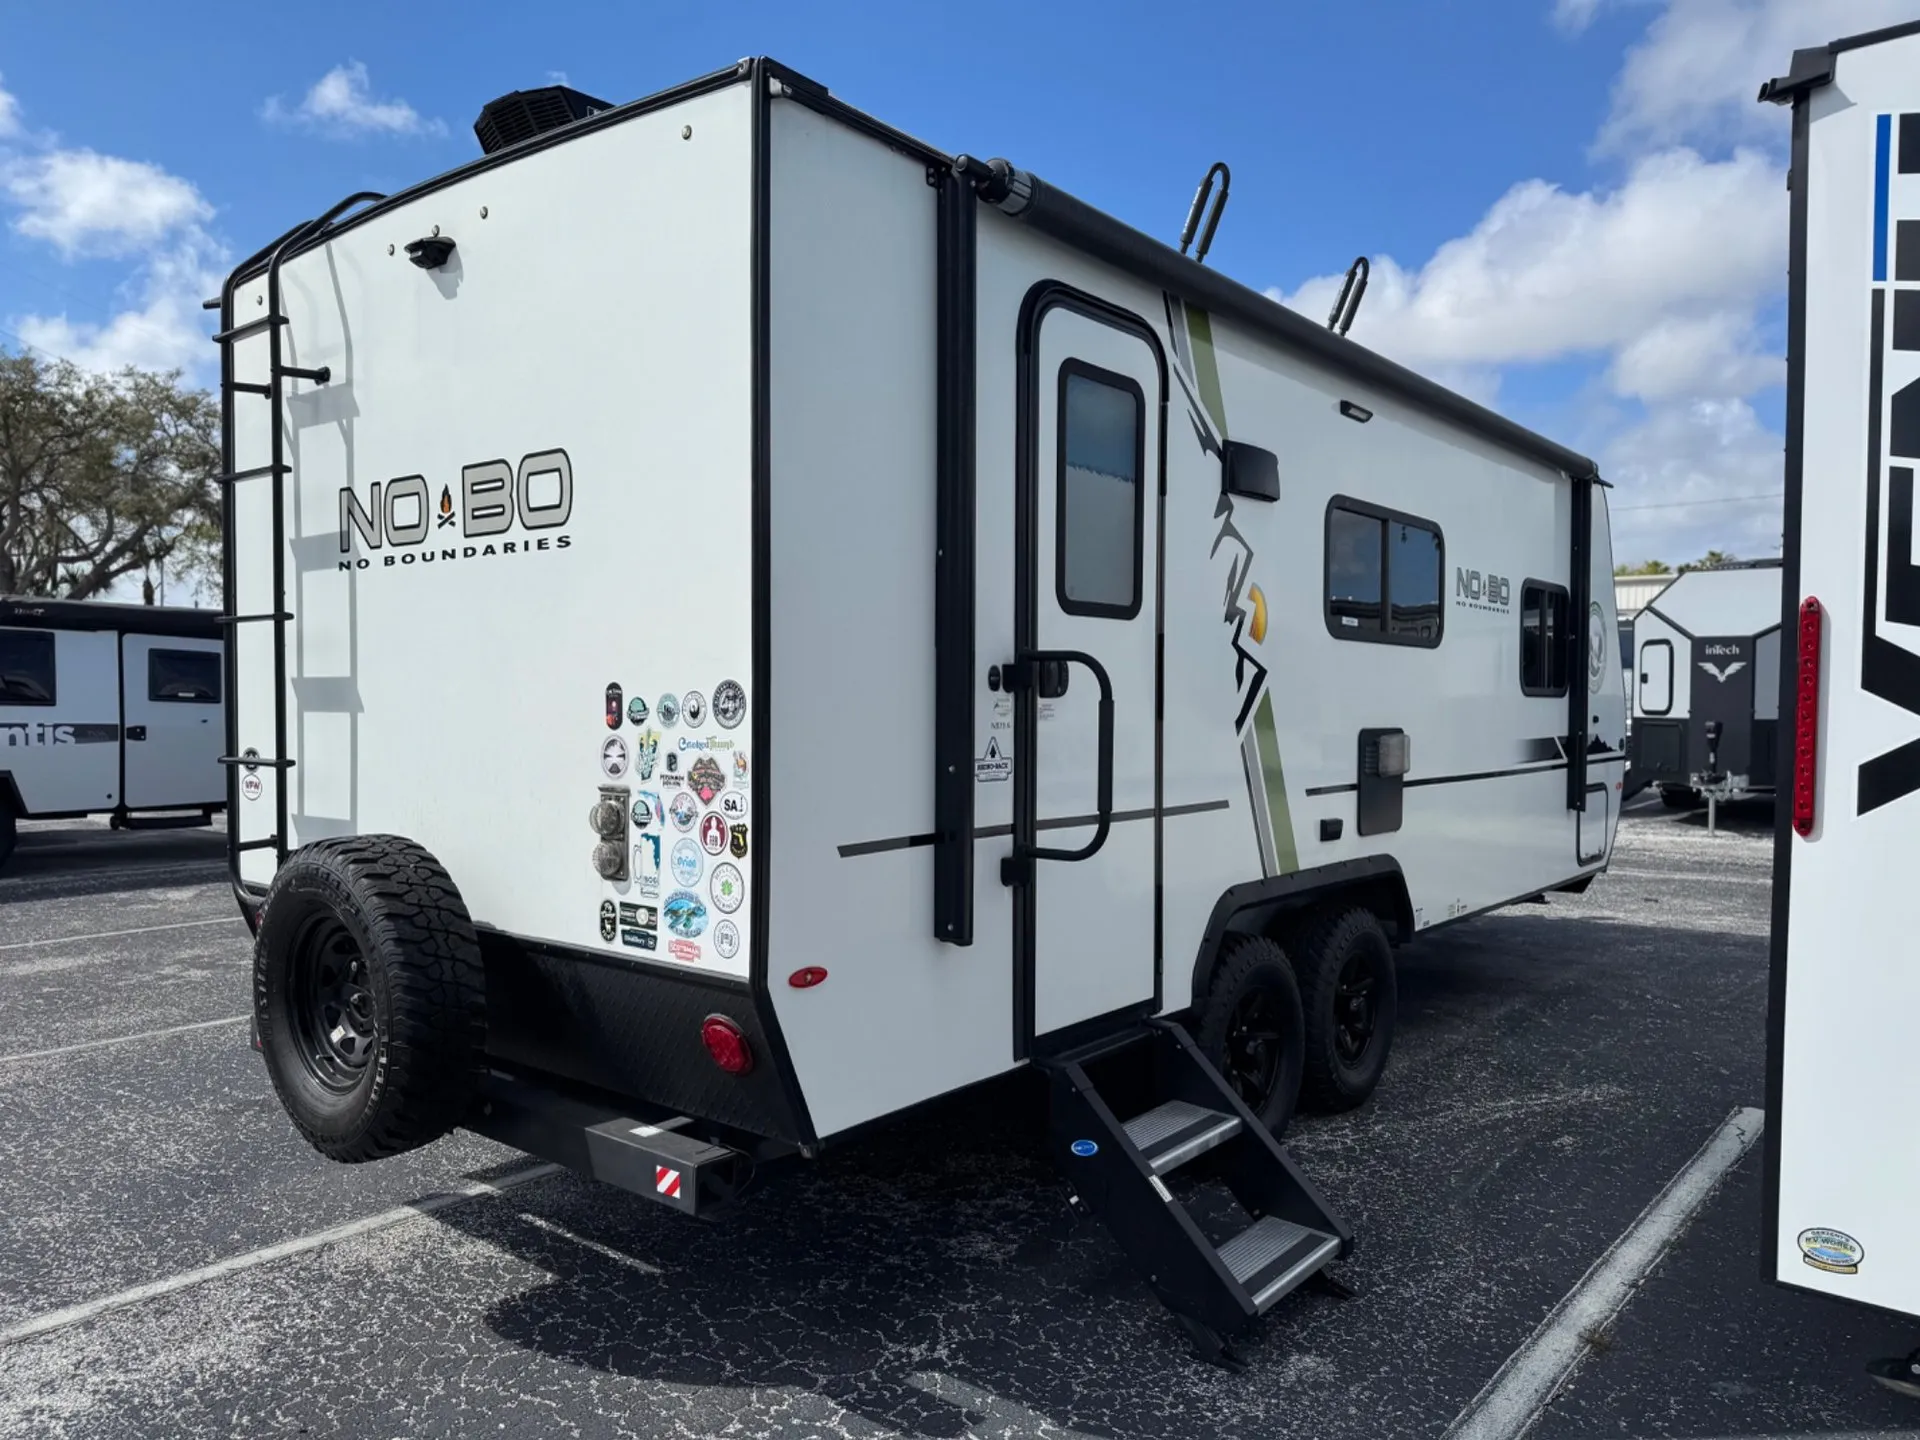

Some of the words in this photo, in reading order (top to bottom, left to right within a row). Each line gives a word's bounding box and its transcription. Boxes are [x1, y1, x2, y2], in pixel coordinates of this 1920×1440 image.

[339, 473, 430, 553] NO
[461, 447, 574, 538] BO
[338, 557, 370, 572] NO
[383, 535, 572, 567] BOUNDARIES
[1456, 566, 1481, 601] NO
[1487, 574, 1510, 606] BO
[1469, 603, 1510, 615] BOUNDARIES
[1705, 644, 1740, 656] inTech
[724, 799, 738, 812] SA
